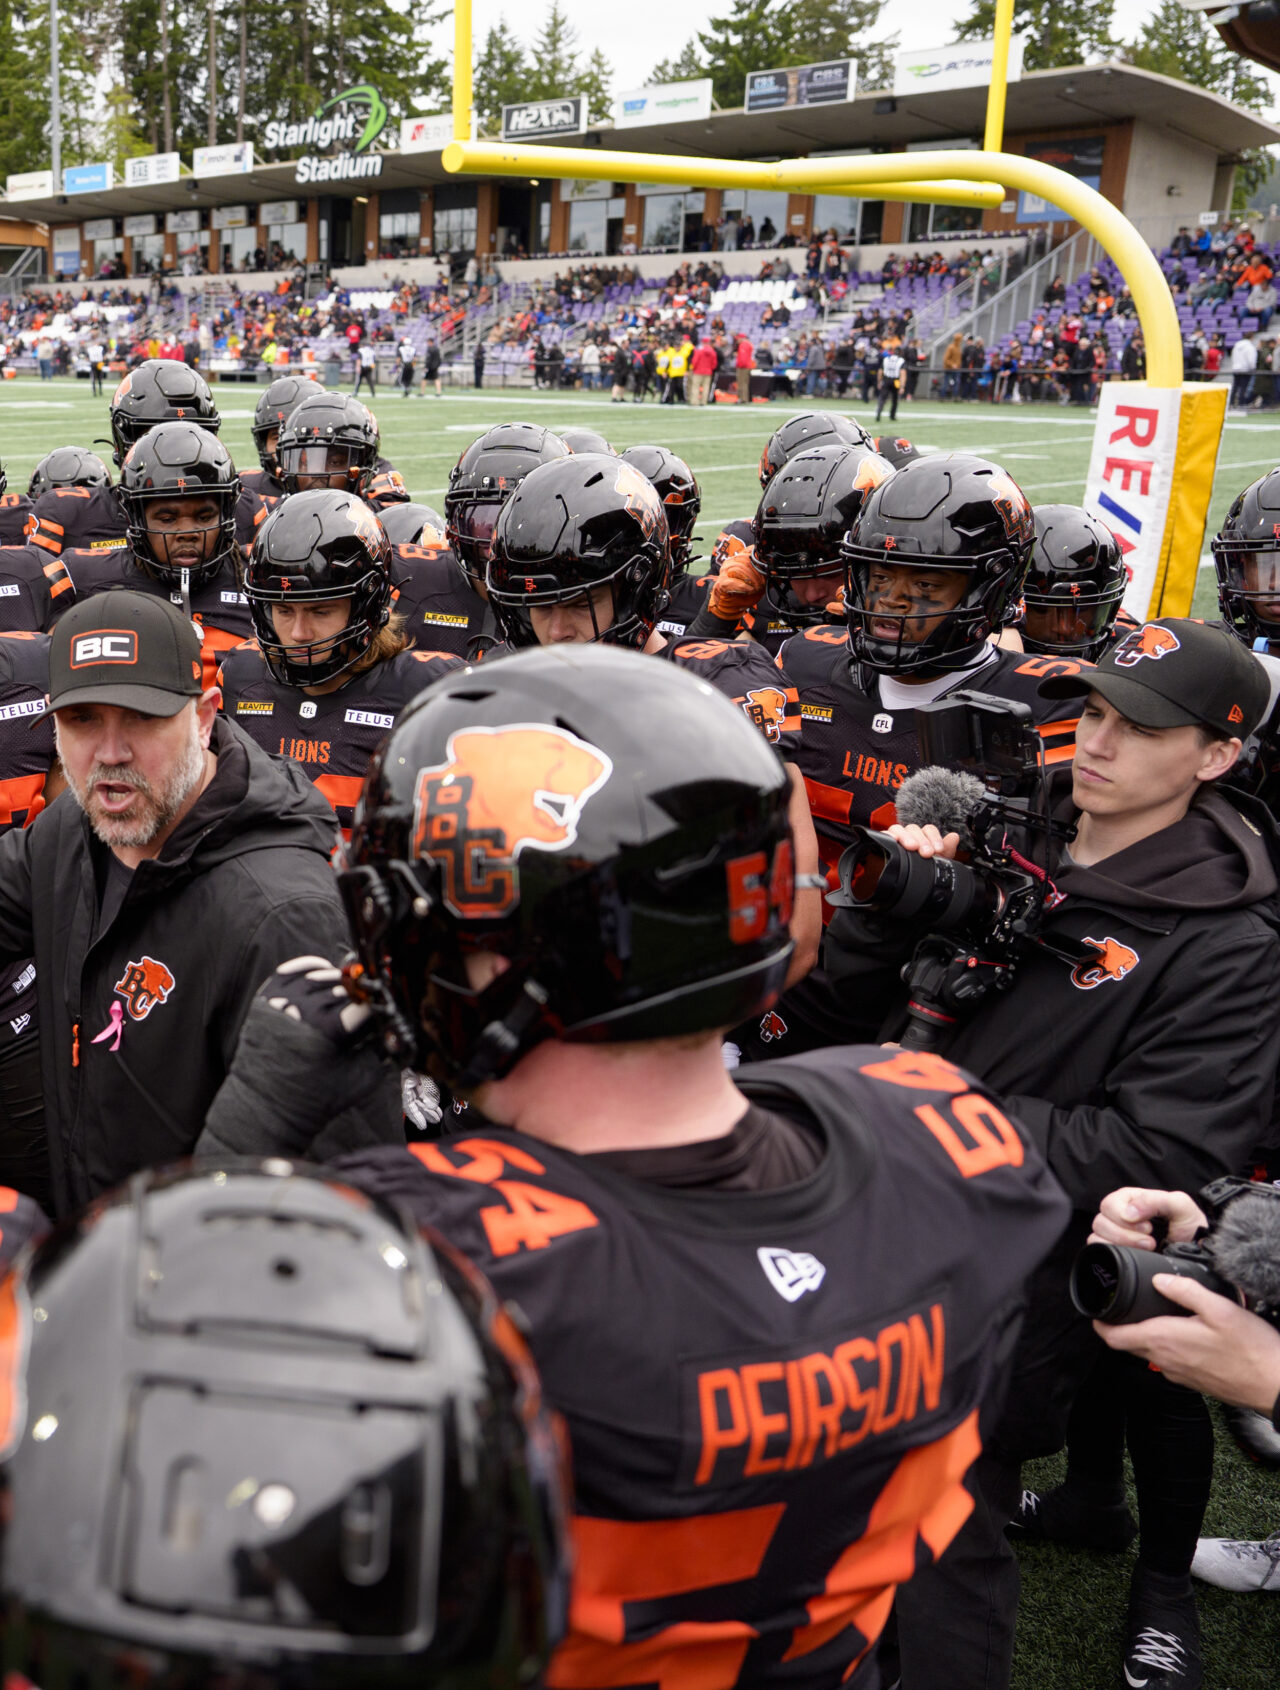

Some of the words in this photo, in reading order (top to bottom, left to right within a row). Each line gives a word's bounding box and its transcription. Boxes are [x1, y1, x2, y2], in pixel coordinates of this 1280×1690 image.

[264, 112, 356, 149] Starlight
[295, 152, 383, 184] Stadium
[425, 612, 469, 624] LEAVITT
[656, 622, 685, 635] ELUS
[75, 636, 130, 662] BC
[238, 702, 273, 712] LEAVITT
[302, 705, 315, 716] CFL
[347, 710, 392, 728] TELUS
[748, 703, 778, 743] BC
[875, 719, 889, 730] CFL
[279, 737, 332, 764] LIONS
[841, 750, 909, 790] LIONS
[416, 771, 520, 918] BC
[114, 961, 158, 1021] BC
[694, 1303, 946, 1487] PEIRSON
